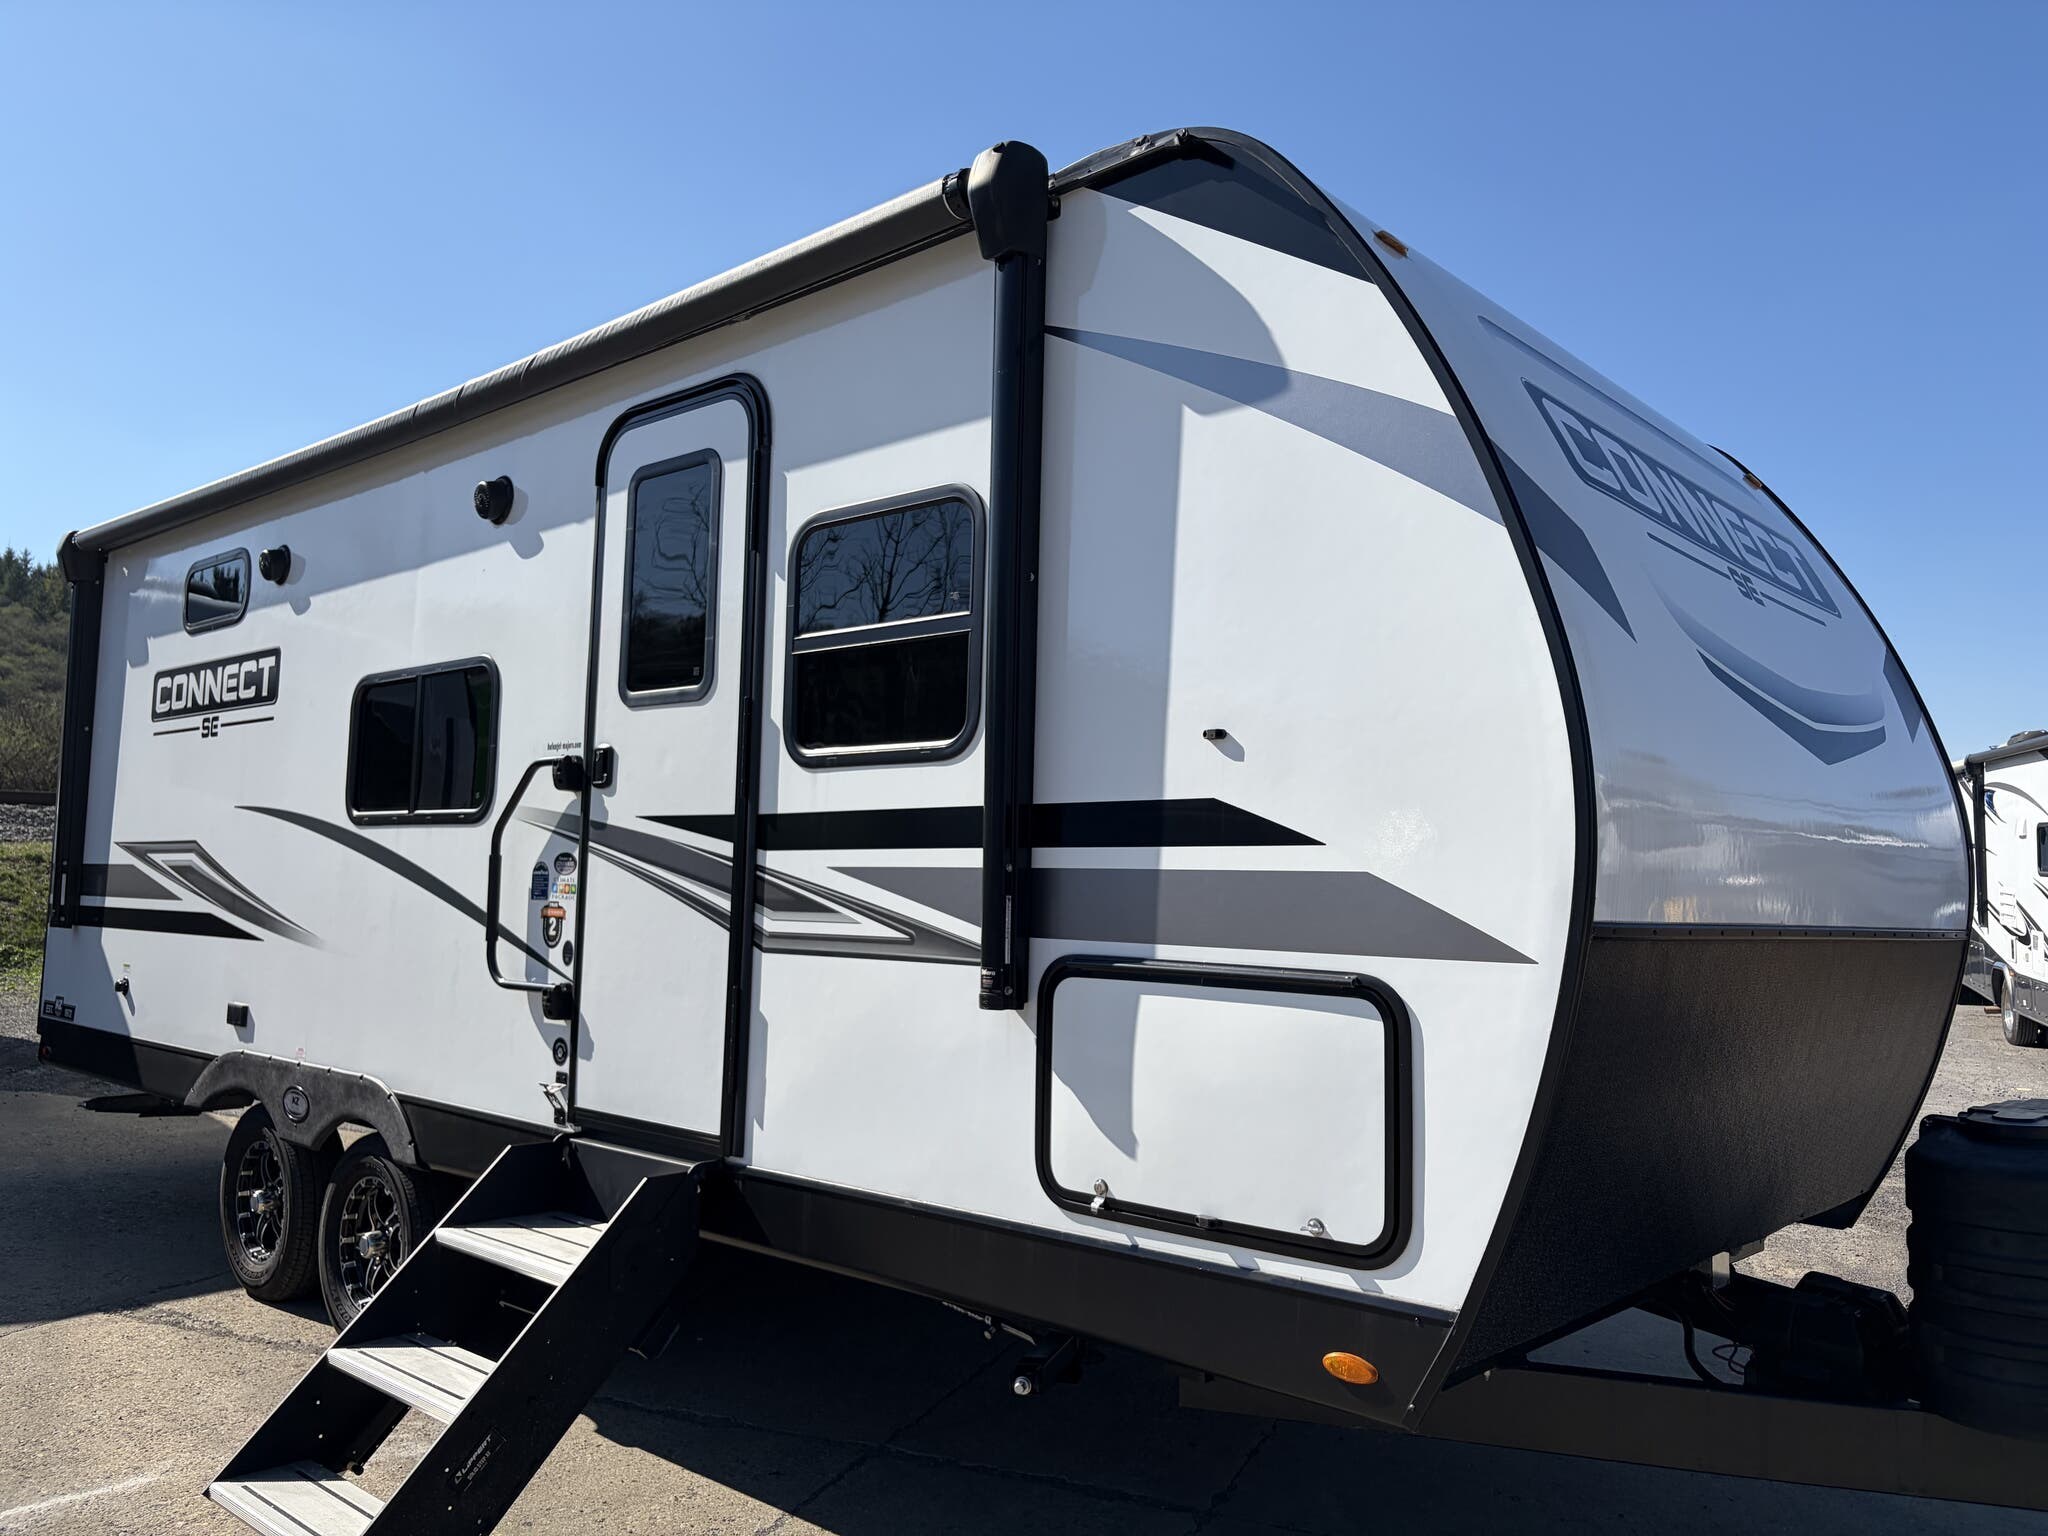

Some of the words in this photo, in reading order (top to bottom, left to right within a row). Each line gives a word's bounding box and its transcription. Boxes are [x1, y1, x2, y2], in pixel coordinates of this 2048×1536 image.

[1541, 397, 1825, 603] CONNECT
[1727, 566, 1766, 607] SE
[154, 655, 277, 714] CONNECT
[201, 716, 220, 738] SE
[548, 916, 557, 936] 2
[461, 1433, 491, 1474] LIPPERT
